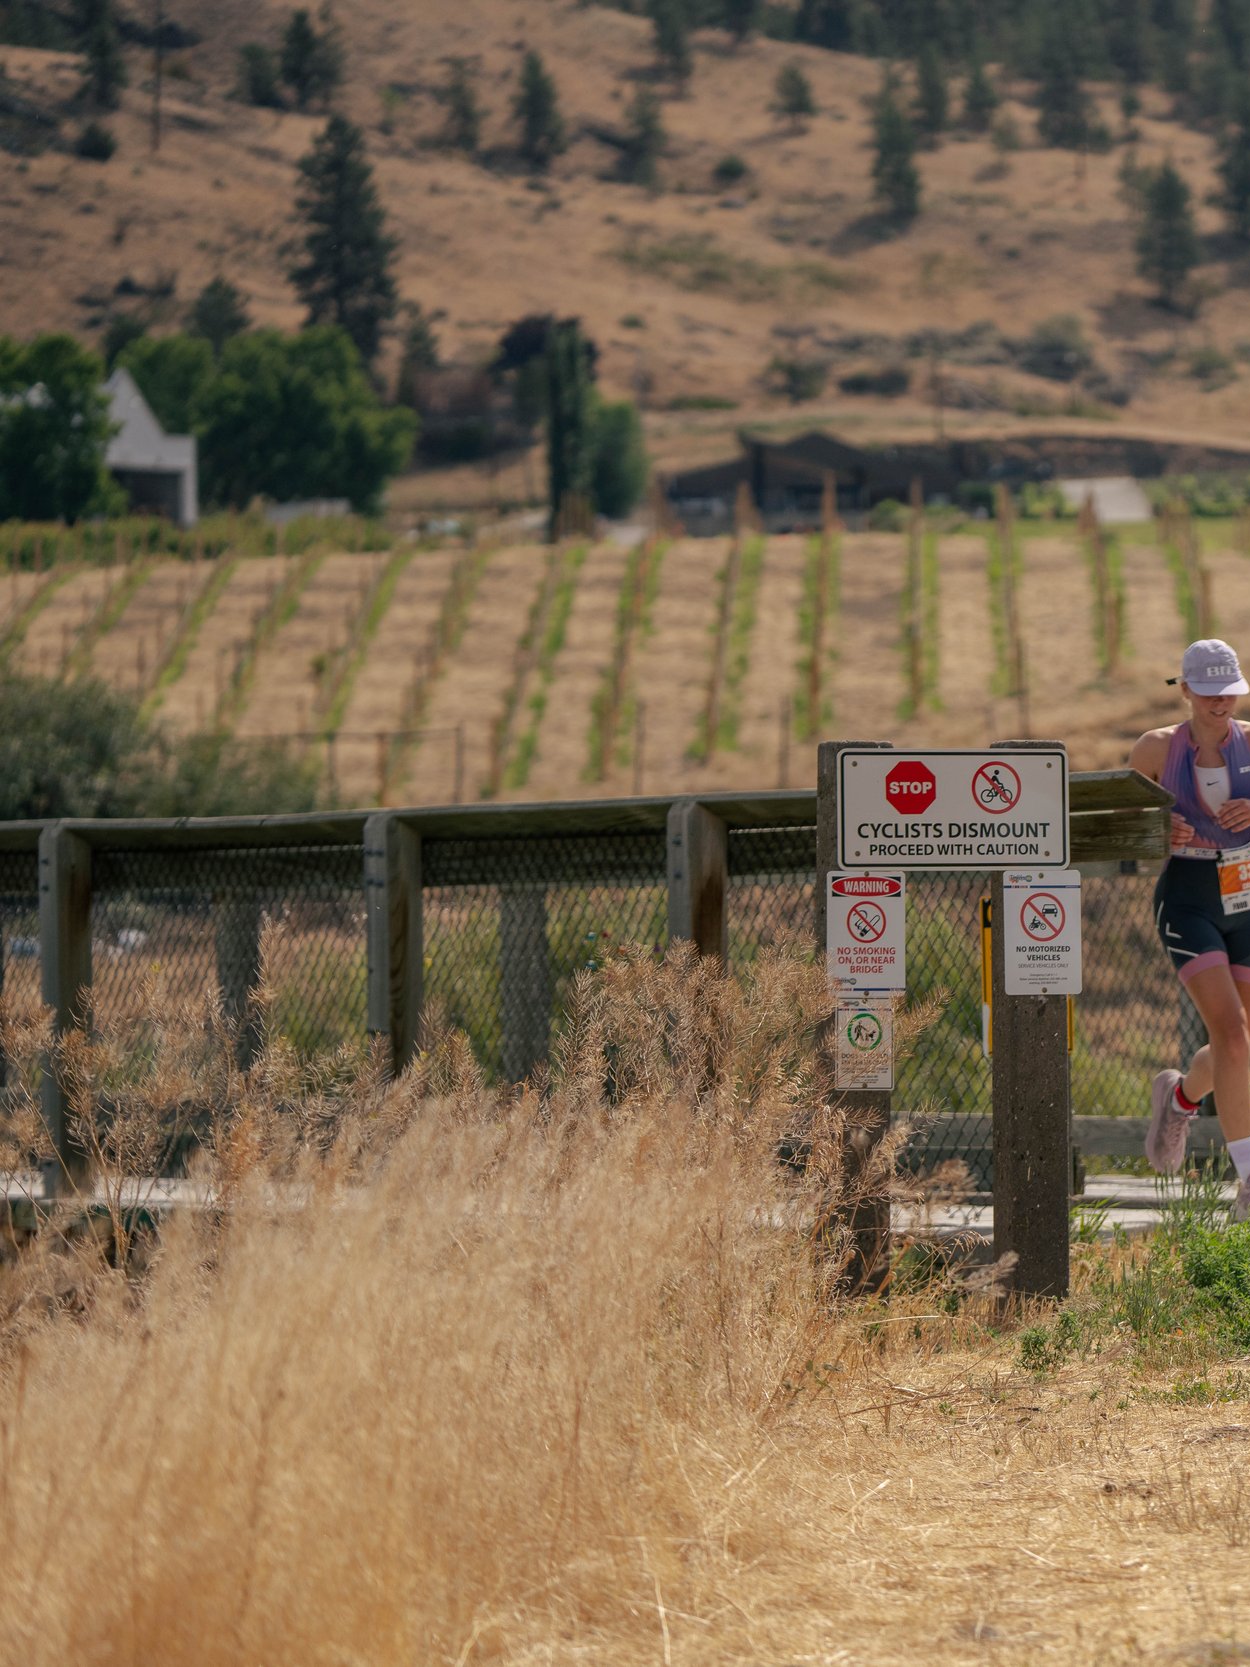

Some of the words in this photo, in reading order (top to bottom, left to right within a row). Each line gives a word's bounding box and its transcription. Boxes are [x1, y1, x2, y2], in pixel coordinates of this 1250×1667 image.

[889, 781, 933, 795] STOP
[857, 823, 942, 838] CYCLISTS
[949, 822, 1050, 838] DISMOUNT
[870, 844, 934, 856] PROCEED
[938, 844, 973, 856] WITH
[976, 843, 1039, 856] CAUTION
[844, 881, 890, 894] WARNING
[837, 947, 851, 955] NO
[853, 947, 896, 955] SMOKING
[1016, 945, 1027, 953] NO
[1028, 945, 1071, 953] MOTORIZED
[838, 956, 855, 965] ON,
[856, 956, 869, 964] OR
[870, 956, 895, 964] NEAR
[850, 965, 884, 974] BRIDGE
